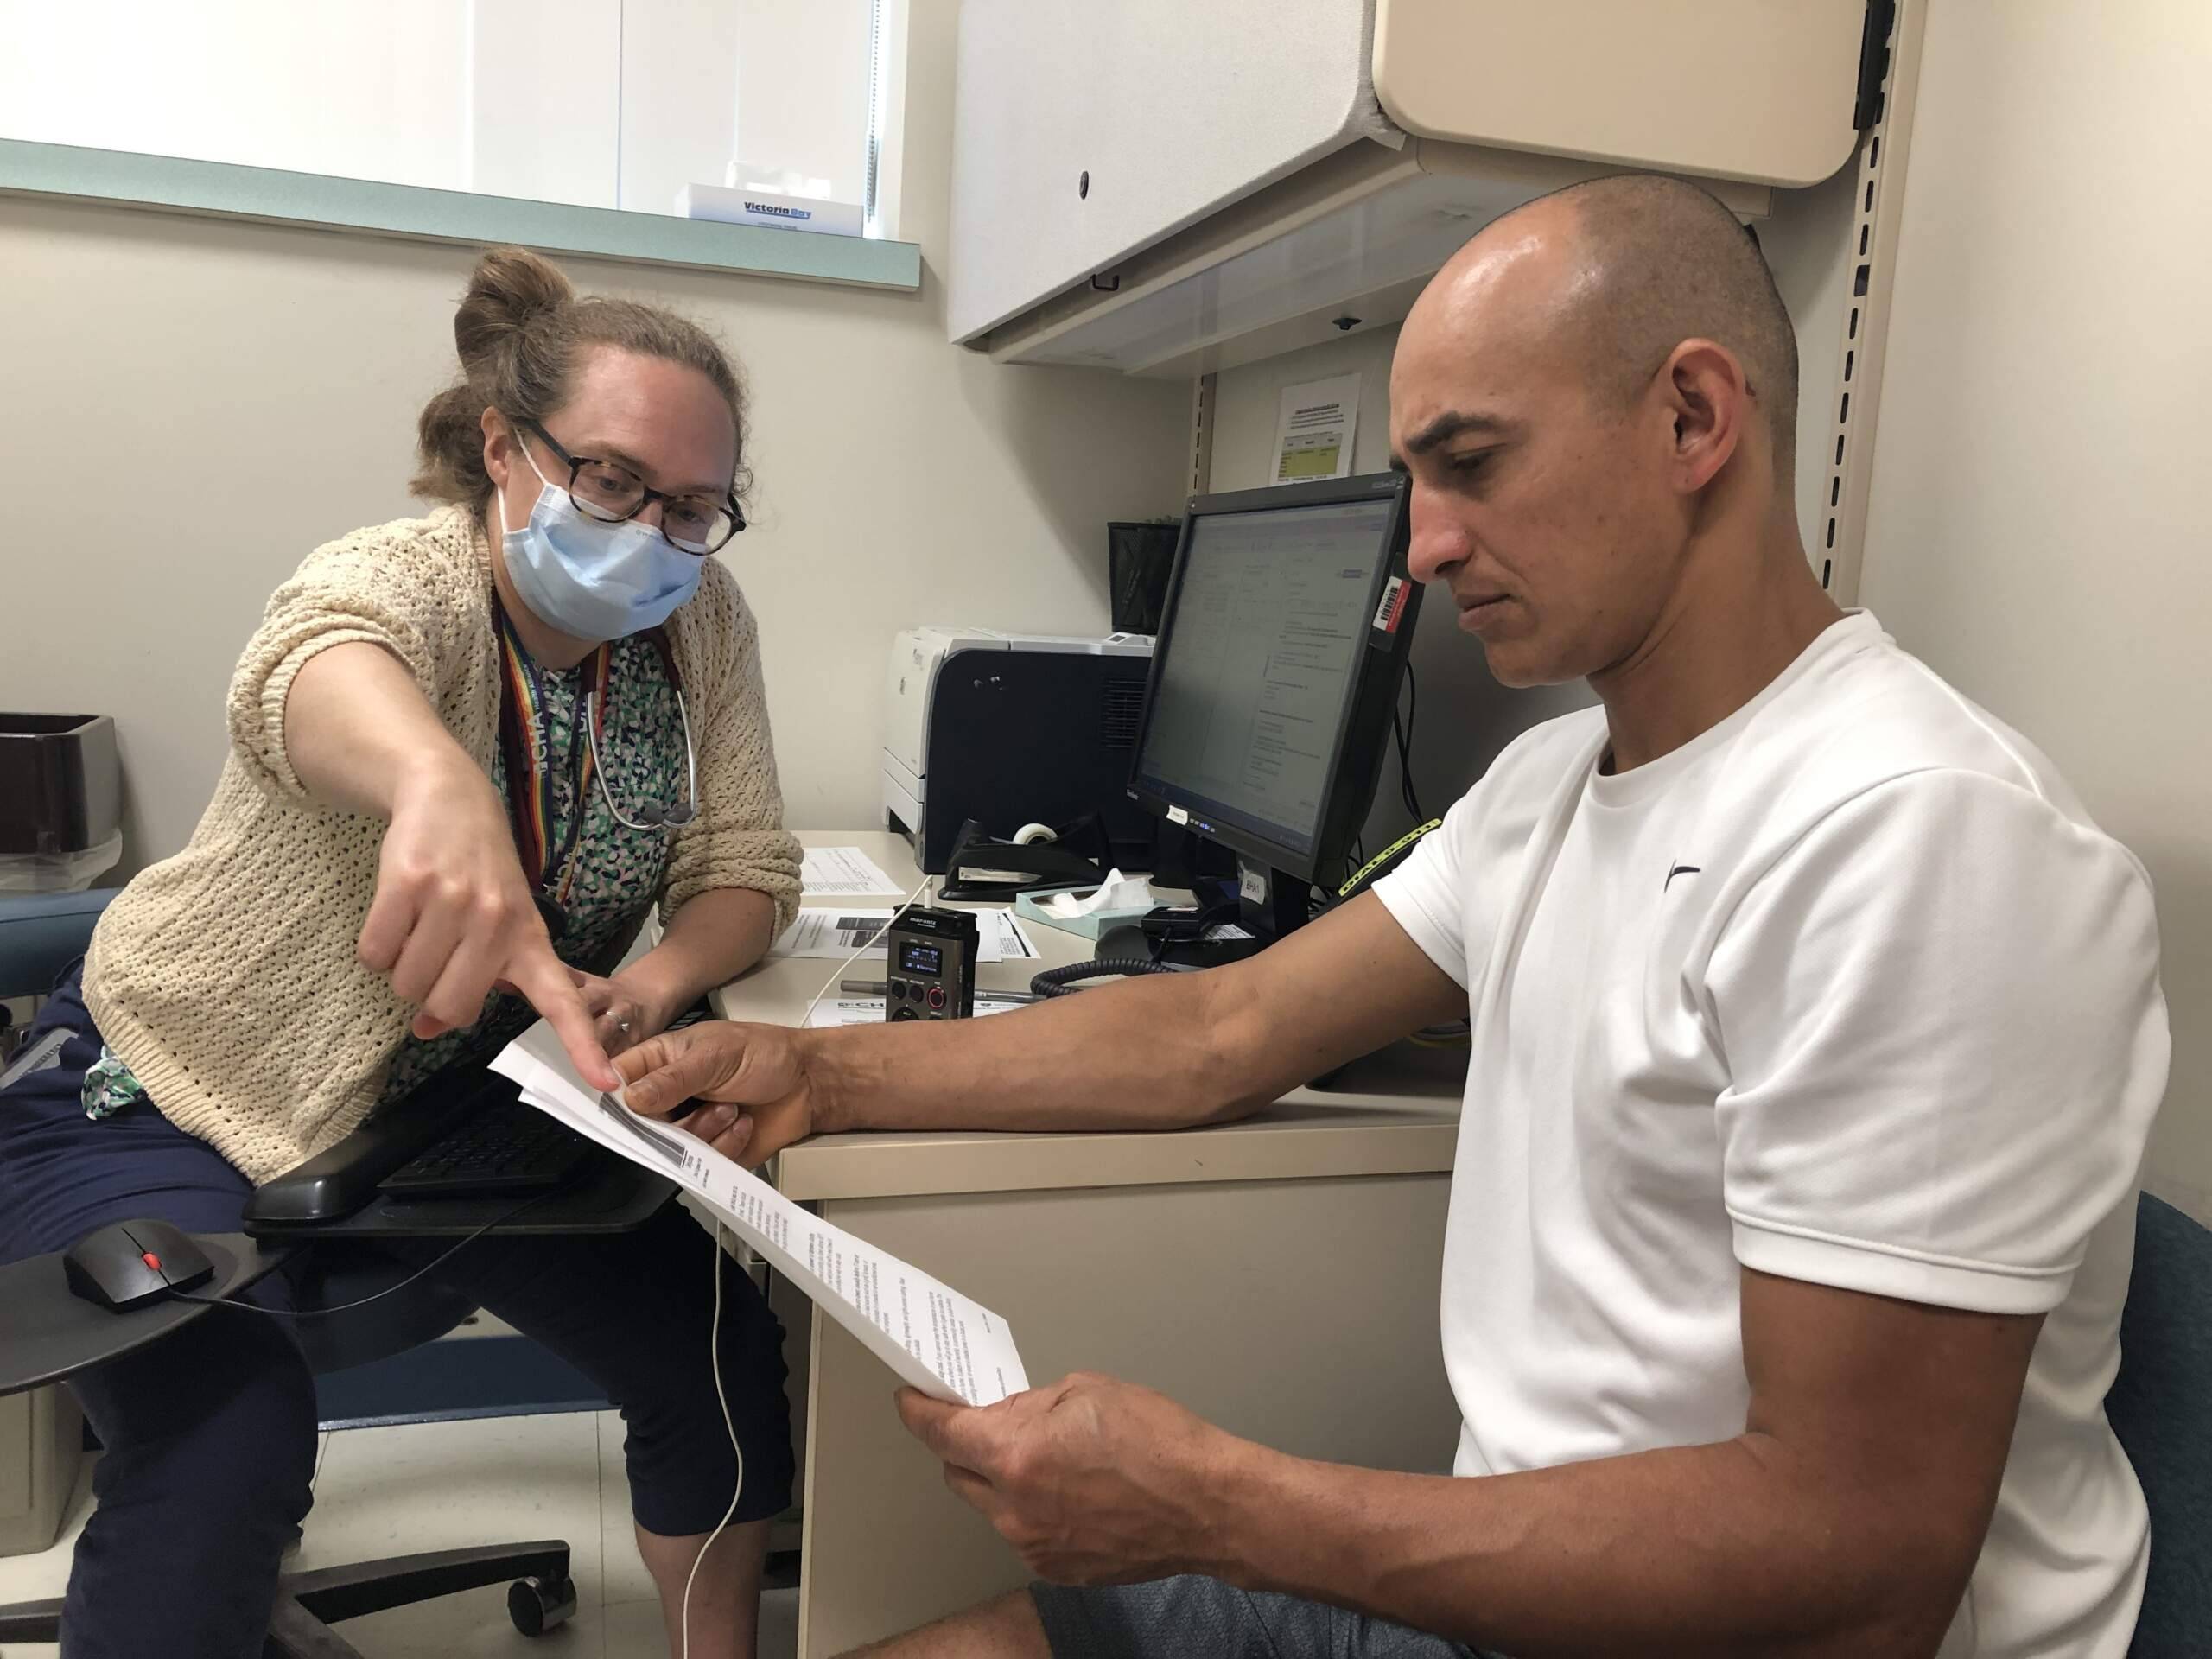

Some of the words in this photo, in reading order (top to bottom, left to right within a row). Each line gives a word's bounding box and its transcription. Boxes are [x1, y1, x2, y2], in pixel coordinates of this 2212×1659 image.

[744, 200, 790, 215] Victoria
[791, 207, 812, 219] Bay
[525, 711, 548, 762] CHA
[1343, 859, 1382, 893] DIAL
[909, 917, 937, 925] marantz
